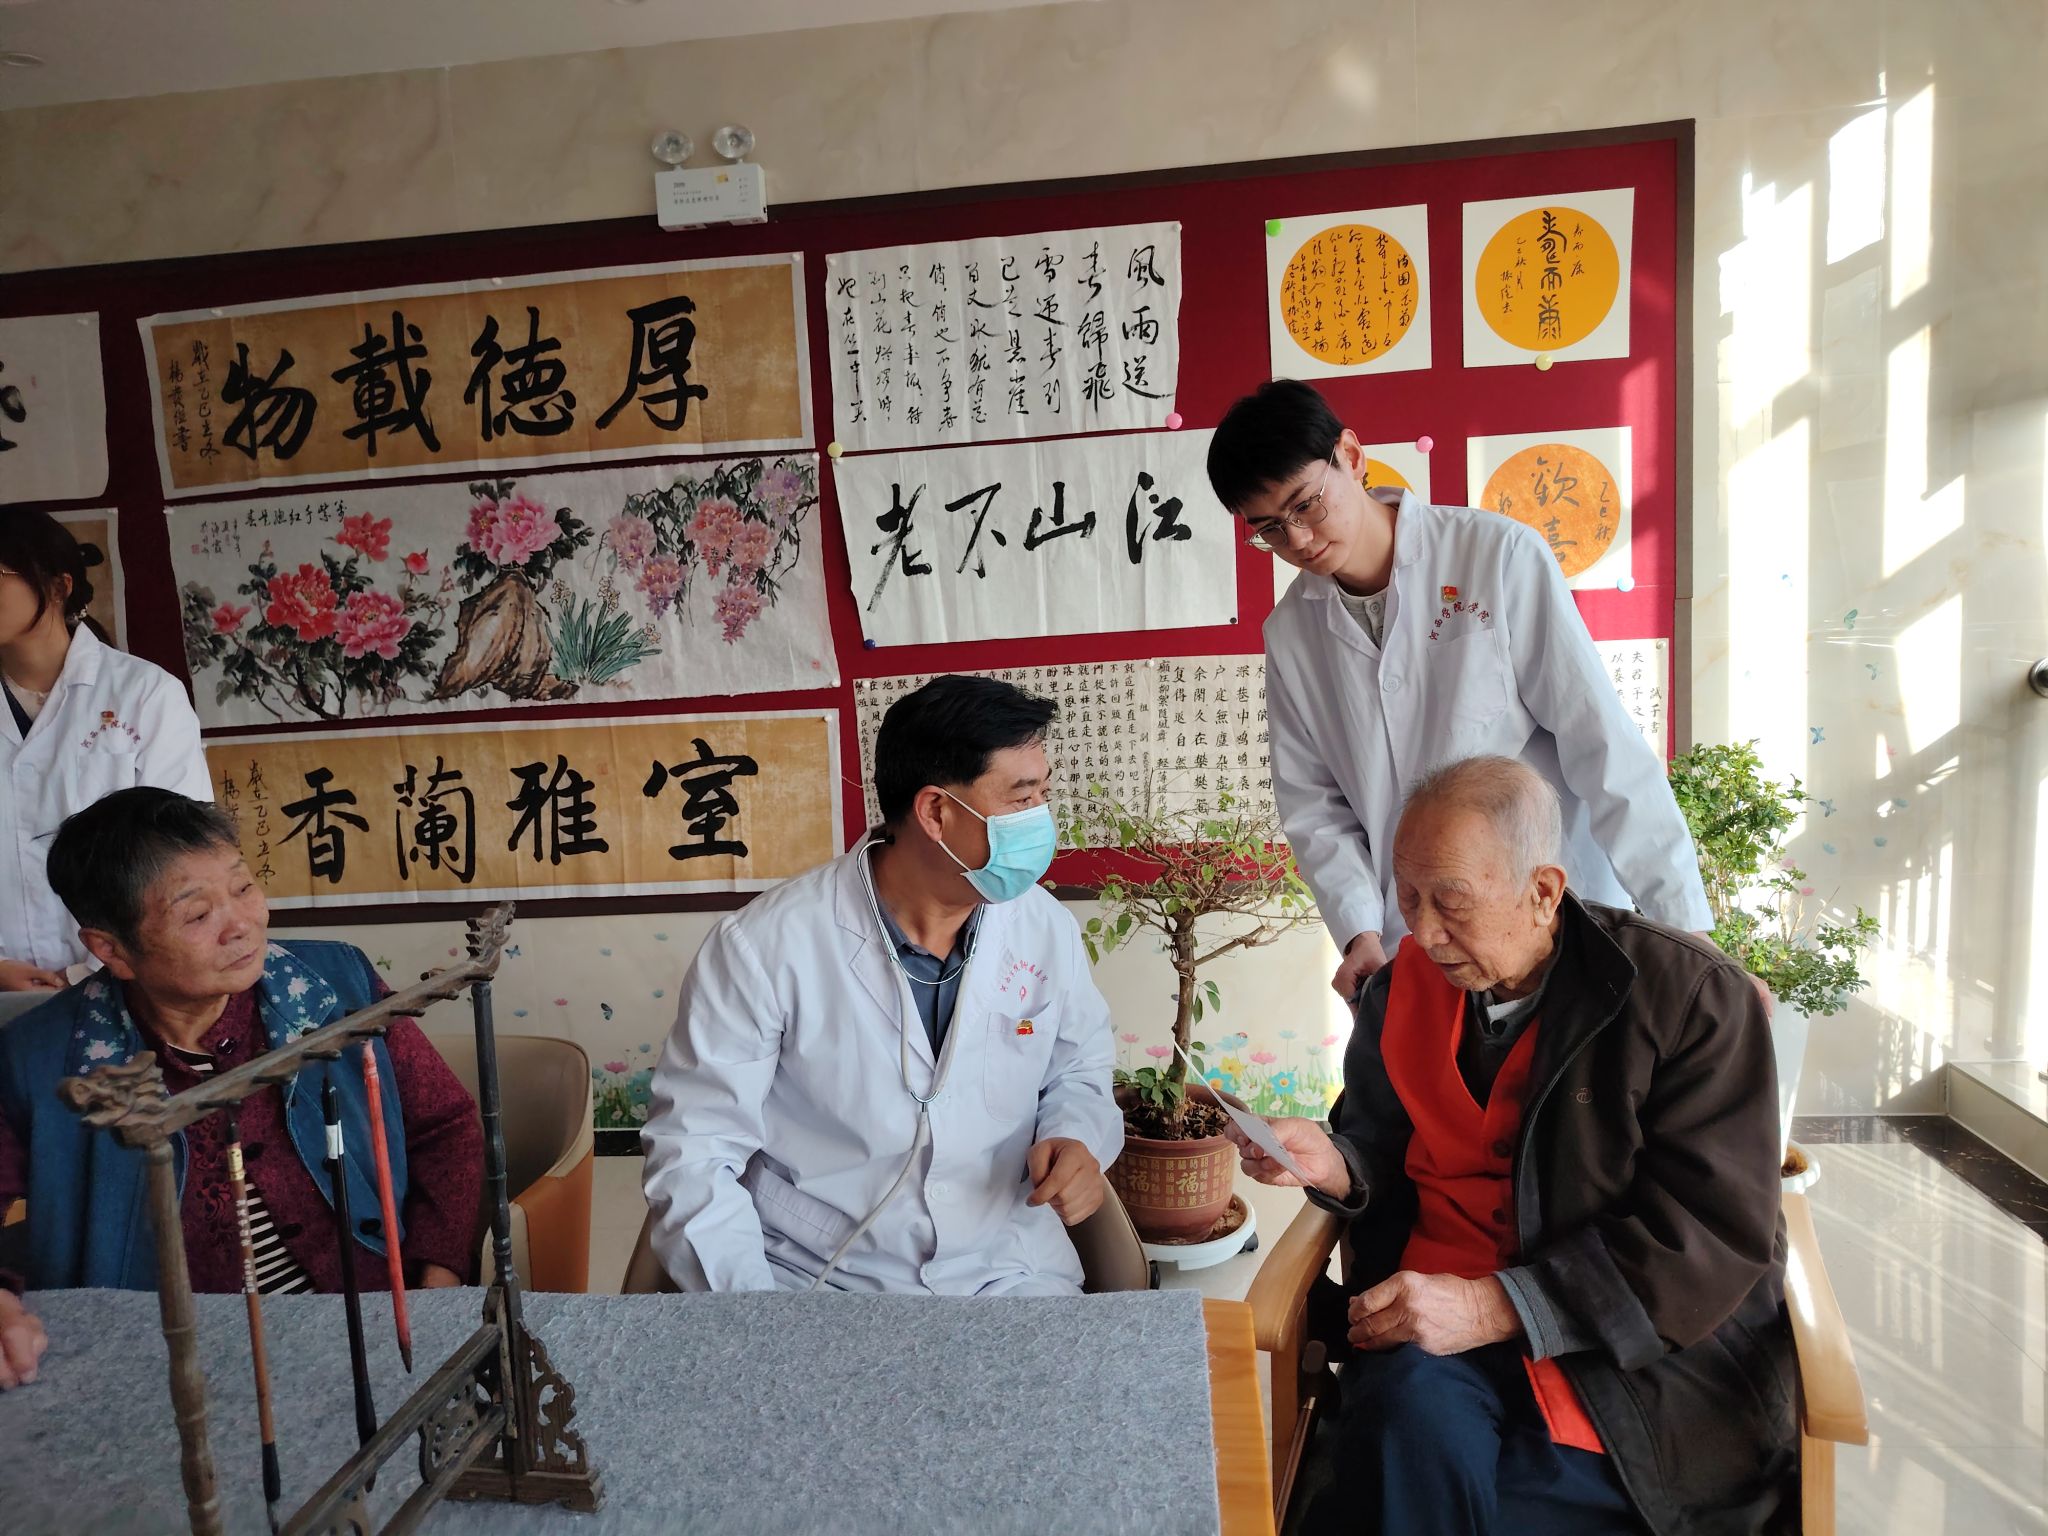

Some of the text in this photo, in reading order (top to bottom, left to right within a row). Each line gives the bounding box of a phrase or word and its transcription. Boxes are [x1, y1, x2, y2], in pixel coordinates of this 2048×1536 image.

[866, 471, 1193, 613] 江山不老
[1127, 1170, 1150, 1193] 福
[1175, 1170, 1199, 1195] 福
